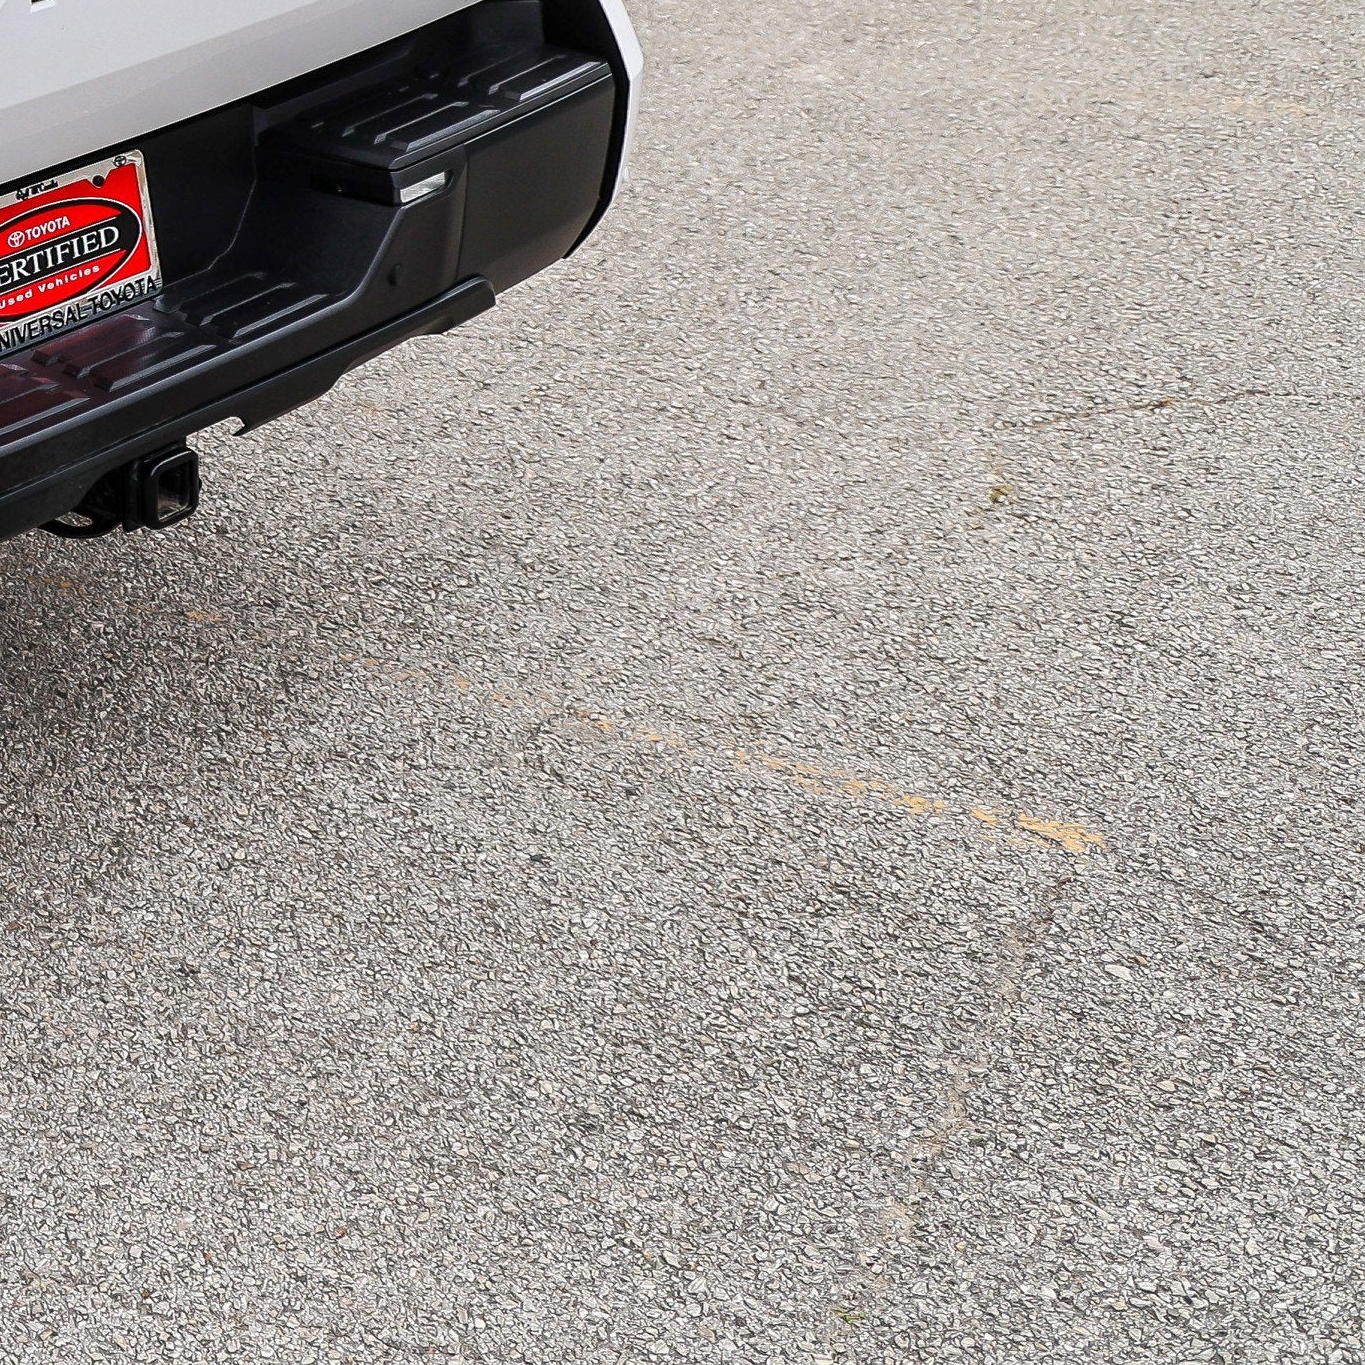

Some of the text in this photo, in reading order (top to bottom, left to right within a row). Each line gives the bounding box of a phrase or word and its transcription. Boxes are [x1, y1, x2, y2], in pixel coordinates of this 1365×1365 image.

[25, 215, 71, 241] TOYOTA
[37, 264, 101, 294] Vehicles
[90, 273, 158, 316] TOYOTA
